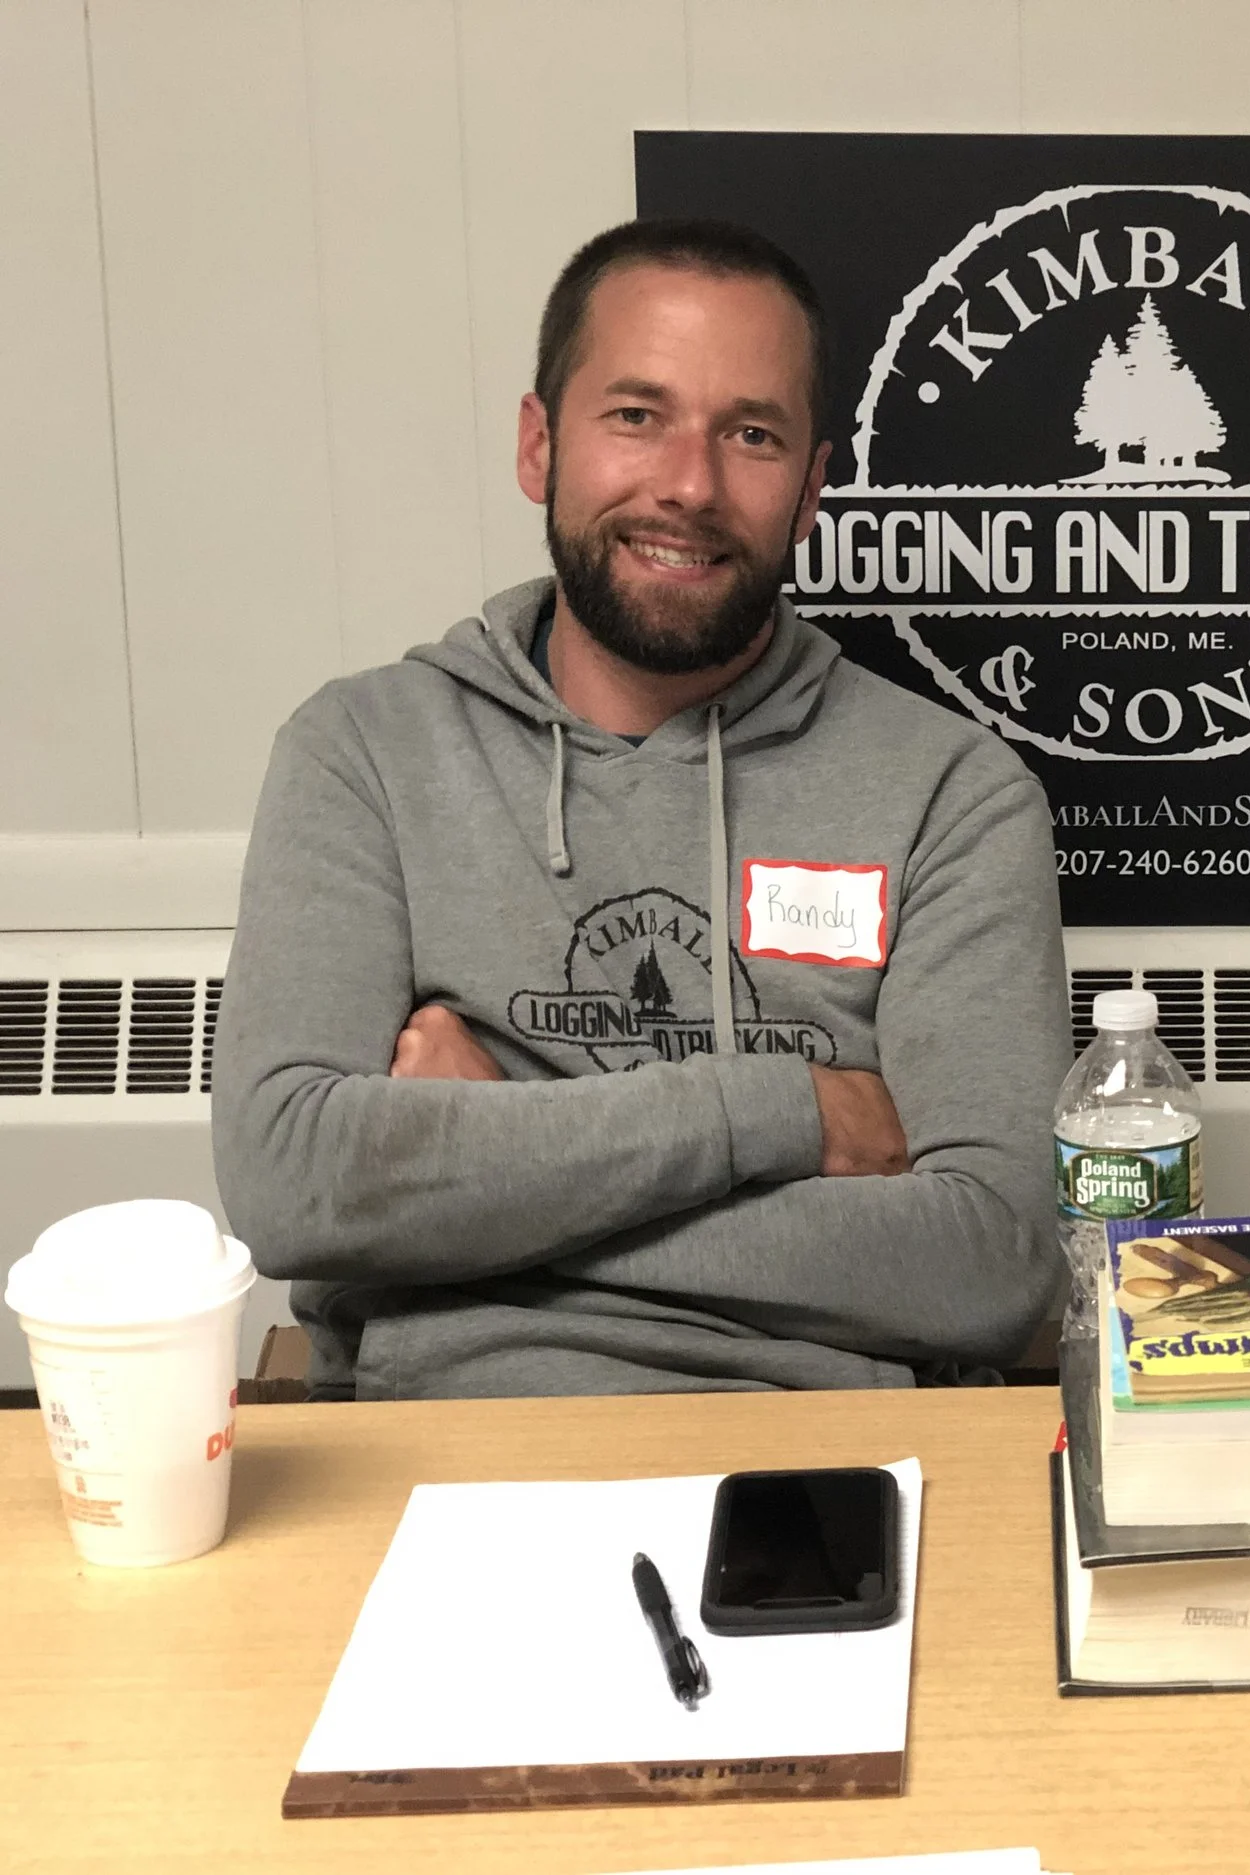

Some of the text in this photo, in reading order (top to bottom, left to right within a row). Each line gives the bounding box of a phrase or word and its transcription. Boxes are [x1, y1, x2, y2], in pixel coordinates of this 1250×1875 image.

[781, 511, 1033, 594] OGGING
[1055, 511, 1190, 593] AND
[1061, 631, 1233, 652] POLAND, ME.
[767, 884, 857, 948] Randy
[1080, 1158, 1142, 1178] Poland
[1076, 1177, 1151, 1208] Spring
[1162, 1225, 1238, 1236] BASEMENT
[648, 1765, 704, 1782] Pad
[717, 1760, 797, 1779] Legal
